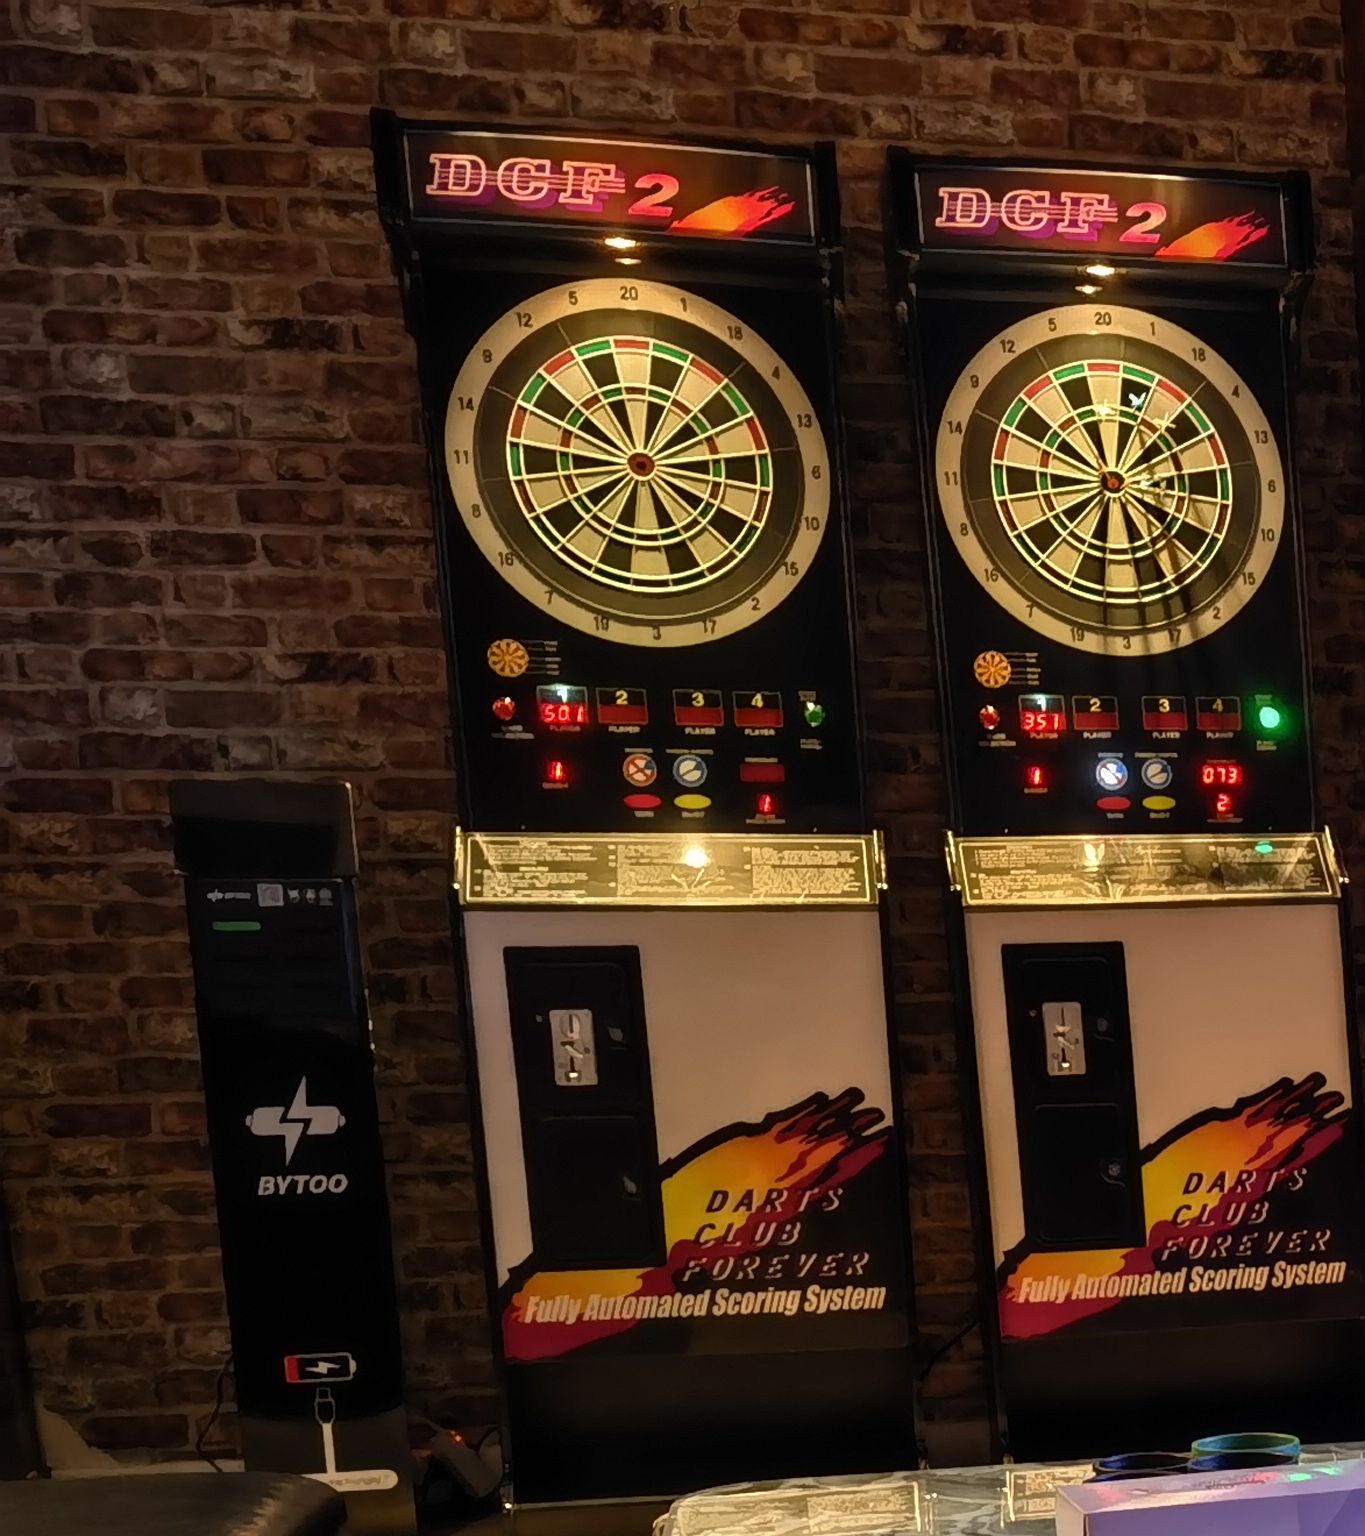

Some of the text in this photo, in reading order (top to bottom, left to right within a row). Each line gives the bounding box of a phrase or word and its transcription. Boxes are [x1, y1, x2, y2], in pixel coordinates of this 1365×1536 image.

[426, 154, 680, 217] DCF 2
[935, 187, 1167, 243] DCF 2
[567, 289, 579, 306] 5
[619, 285, 639, 303] 20
[680, 297, 689, 312] 1
[516, 312, 533, 329] 12
[1047, 315, 1058, 333] 5
[1093, 311, 1113, 327] 20
[726, 325, 744, 343] 18
[1148, 320, 1158, 337] 1
[999, 339, 1017, 355] 12
[1190, 346, 1208, 362] 18
[771, 365, 783, 381] 4
[1229, 384, 1242, 399] 4
[457, 396, 476, 412] 14
[796, 412, 815, 429] 13
[945, 418, 963, 436] 14
[1252, 429, 1270, 446] 13
[452, 449, 470, 465] 11
[810, 465, 822, 481] 6
[942, 470, 959, 486] 11
[1266, 478, 1277, 494] 6
[802, 516, 821, 532] 10
[1260, 527, 1275, 543] 10
[784, 562, 801, 577] 15
[1241, 571, 1258, 587] 15
[543, 589, 556, 606] 7
[750, 598, 763, 613] 2
[1024, 602, 1035, 619] 7
[1212, 605, 1223, 622] 2
[651, 624, 663, 642] 3
[1121, 634, 1132, 651] 3
[557, 687, 569, 703] 1
[615, 690, 629, 705] 2
[691, 691, 705, 707] 3
[751, 692, 765, 708] 4
[1036, 695, 1047, 712] 1
[543, 704, 585, 723] 501
[1089, 698, 1102, 713] 2
[1158, 698, 1171, 713] 3
[1212, 698, 1224, 712] 4
[1023, 712, 1060, 731] 351
[1151, 731, 1181, 740] PLAYER
[1202, 766, 1238, 784] 073
[1216, 793, 1229, 812] 2
[257, 1172, 349, 1197] BYTOO
[1183, 1166, 1309, 1196] DARTS
[705, 1186, 845, 1214] DARTS
[1171, 1200, 1271, 1229] CLUB
[693, 1222, 803, 1249] CLUB
[1160, 1228, 1333, 1263] FOREVER
[682, 1251, 871, 1283] FOREVER
[1018, 1260, 1348, 1305] Fully Automated Scoring System
[524, 1284, 887, 1325] Fully Automated Scoring System
